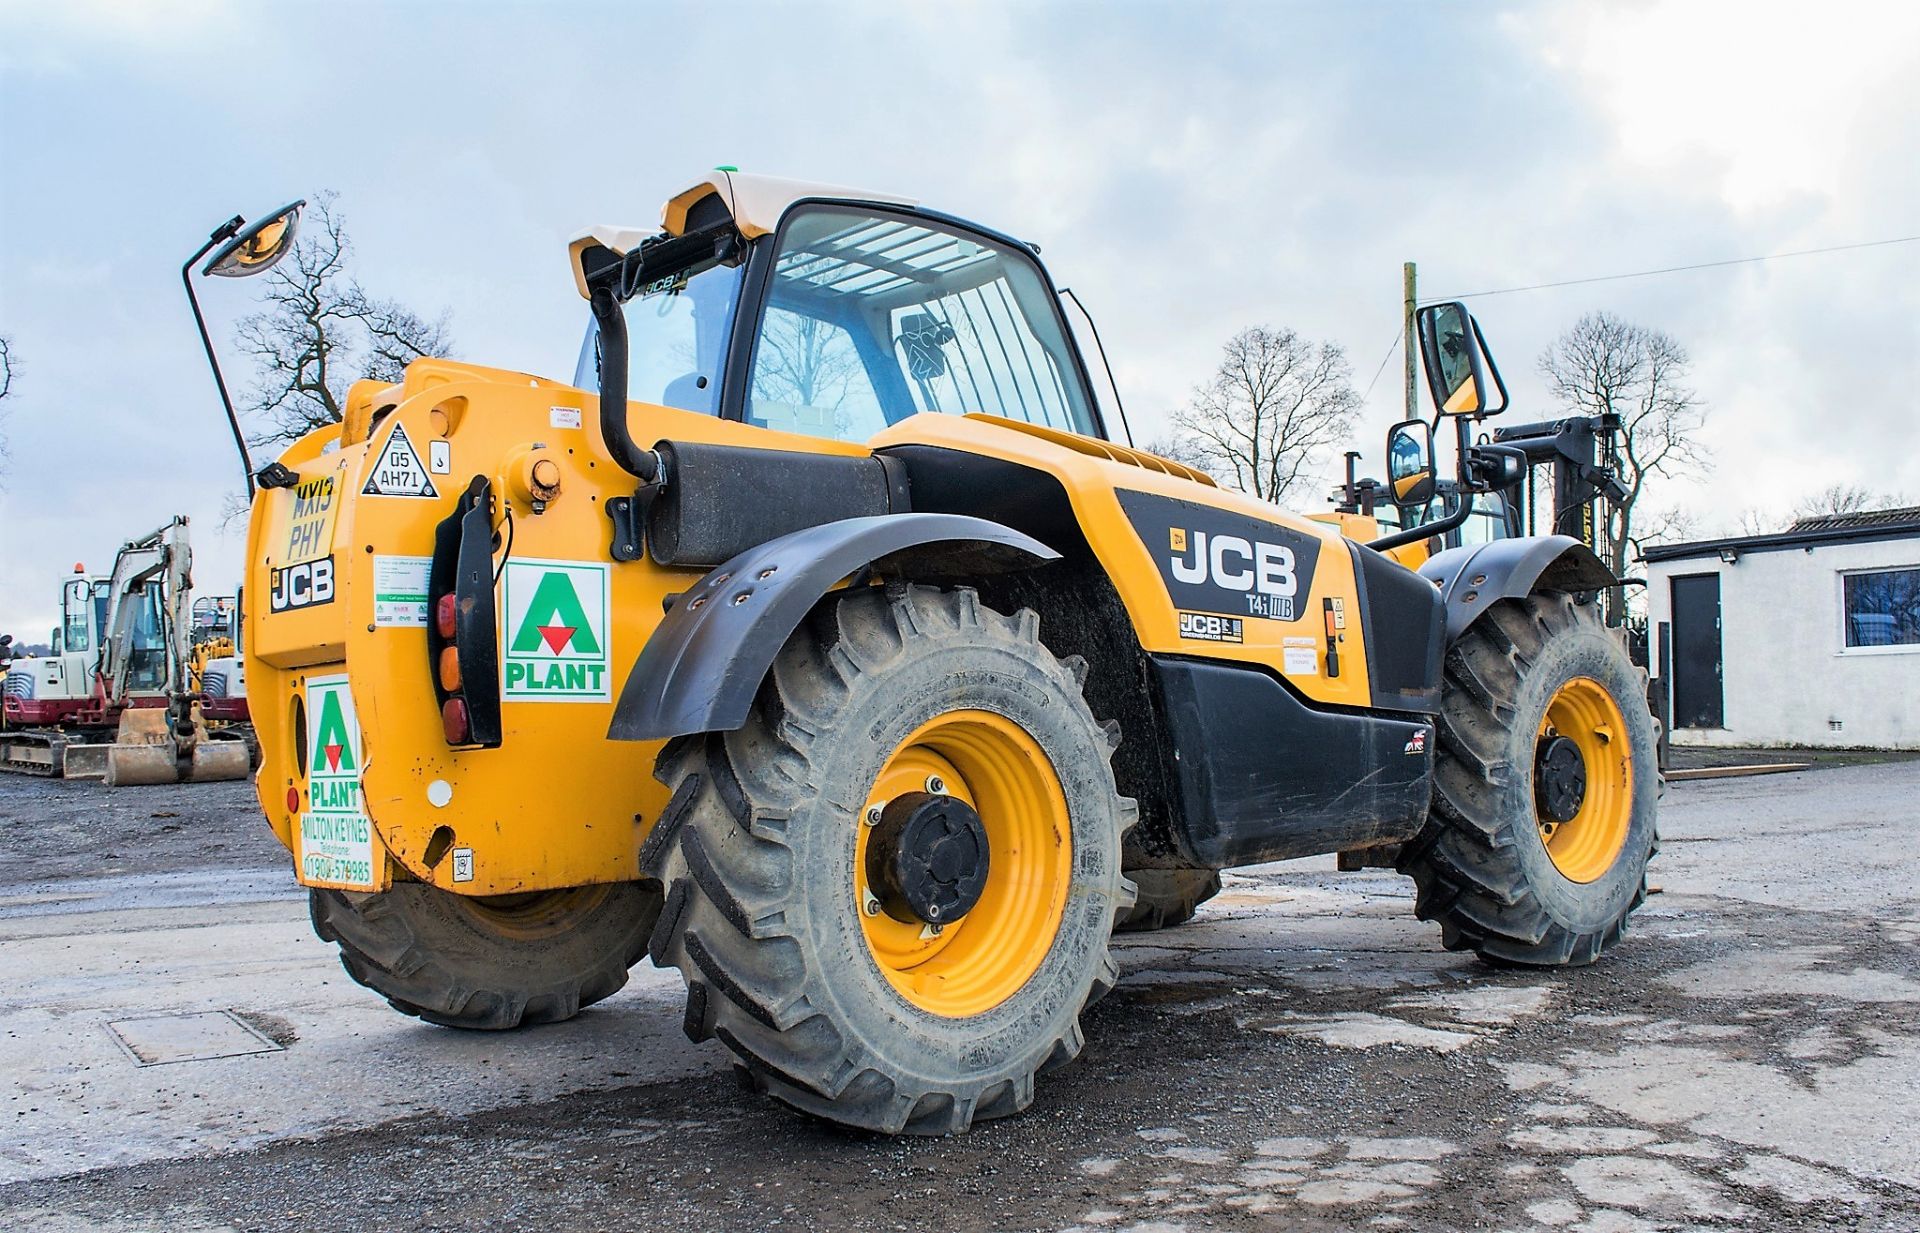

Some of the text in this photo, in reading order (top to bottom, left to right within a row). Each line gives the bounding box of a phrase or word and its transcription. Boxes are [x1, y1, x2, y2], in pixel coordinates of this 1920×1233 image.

[390, 451, 410, 468] 05
[292, 475, 335, 520] MX13
[287, 517, 326, 561] PHY
[1170, 530, 1298, 597] JCB
[271, 558, 334, 610] JCB
[510, 571, 601, 654] A
[1245, 593, 1269, 616] T4i
[1180, 613, 1222, 635] JCB
[505, 662, 606, 690] PLANT
[311, 781, 359, 808] PLANT
[302, 815, 369, 843] MILTON KEYNES
